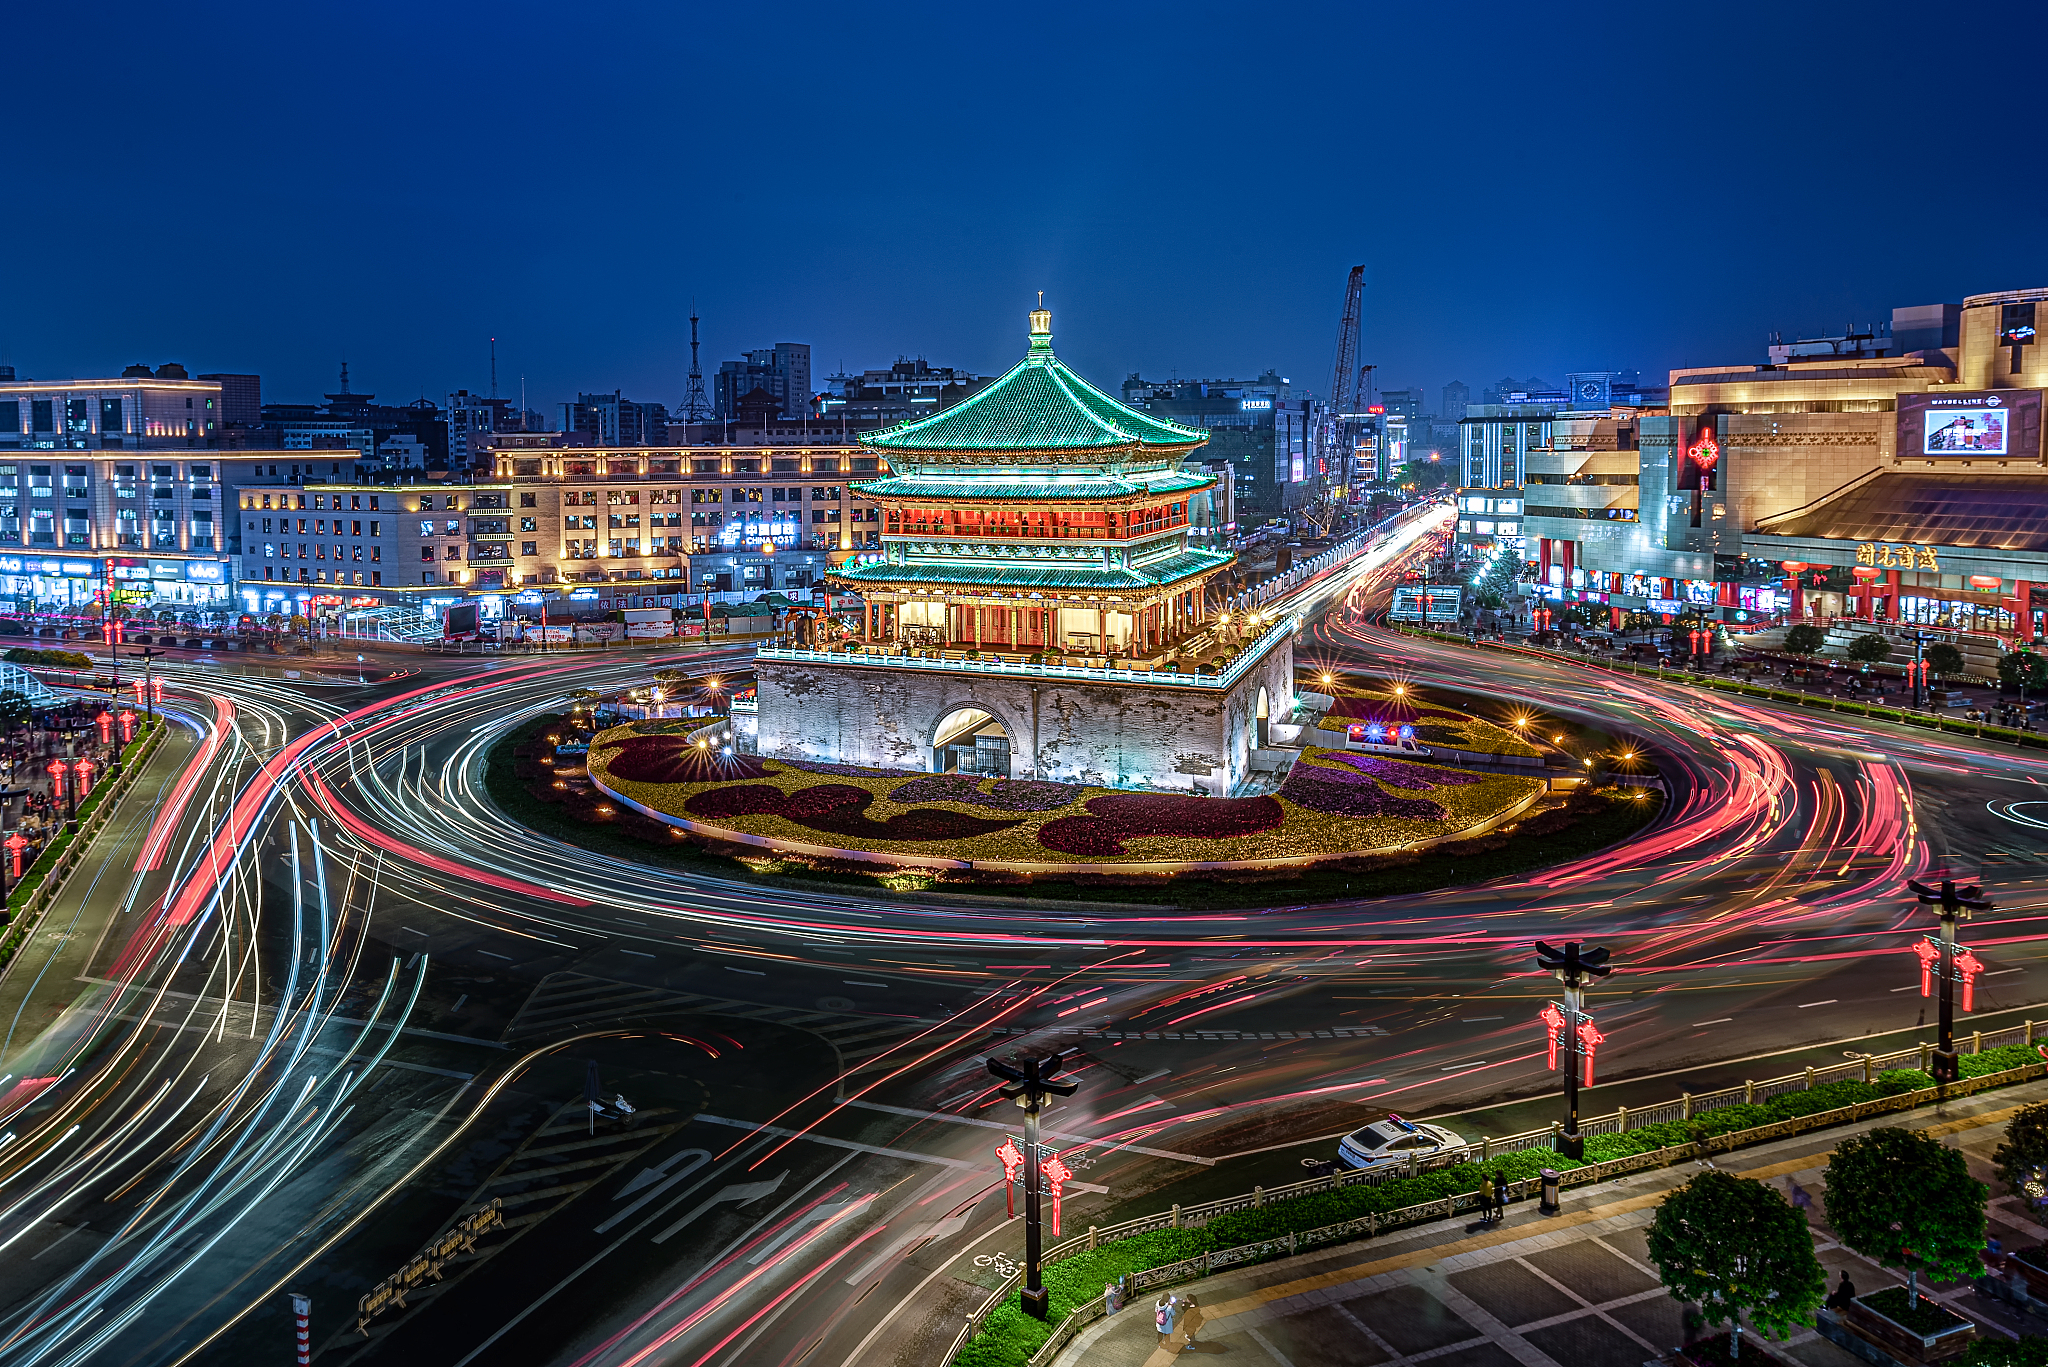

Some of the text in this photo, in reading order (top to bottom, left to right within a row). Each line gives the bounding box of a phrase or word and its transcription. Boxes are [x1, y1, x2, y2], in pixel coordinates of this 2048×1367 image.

[745, 523, 795, 536] 中国邮政
[747, 535, 795, 545] CHINA POST
[0, 556, 21, 571] ivo
[189, 563, 219, 579] vivo
